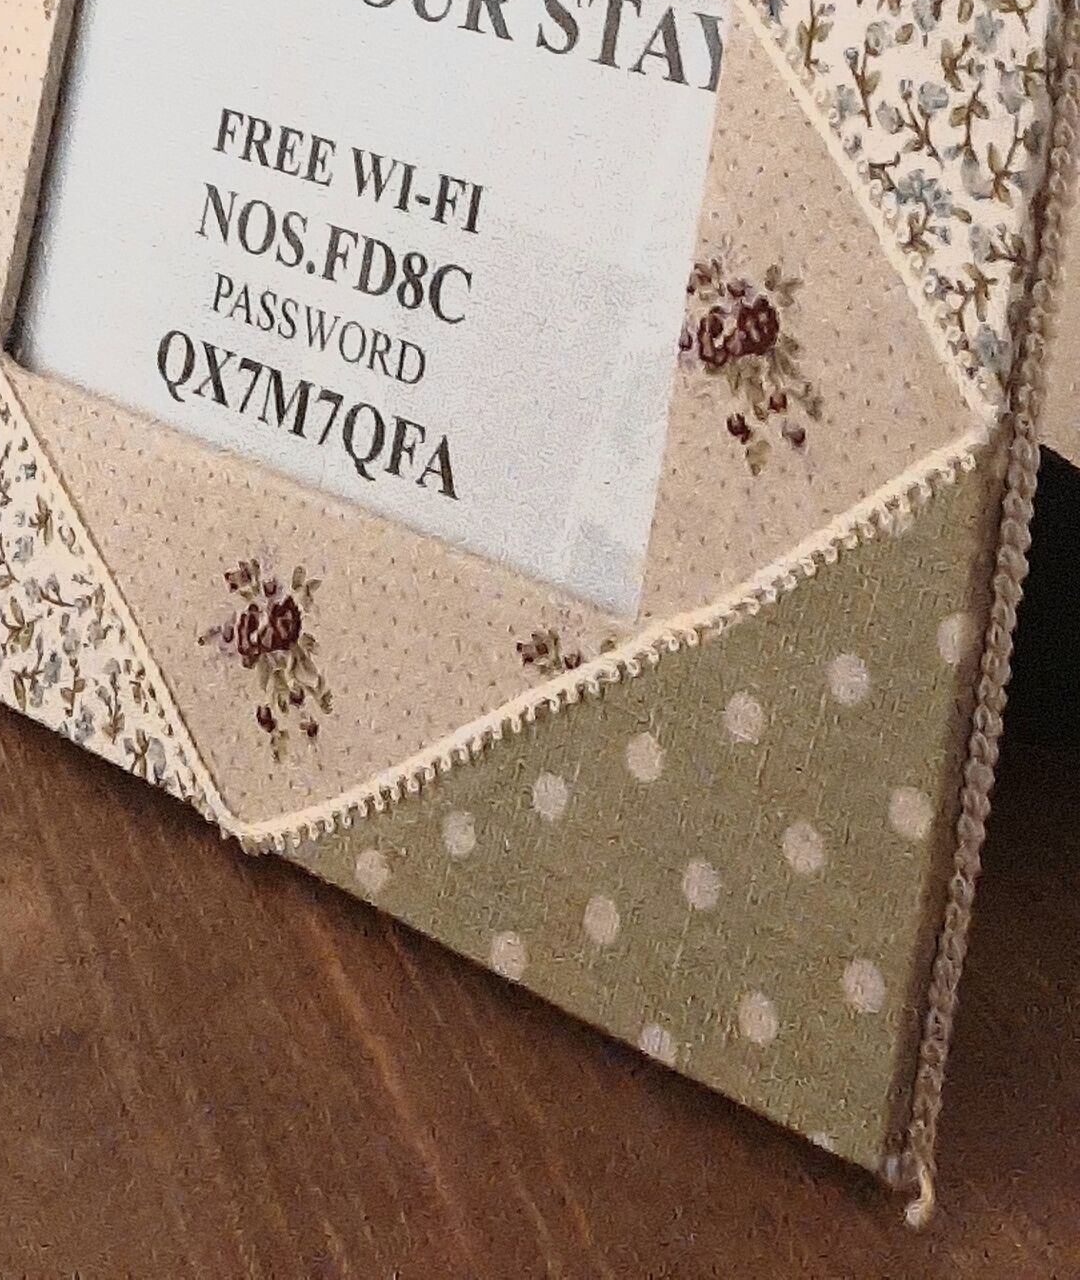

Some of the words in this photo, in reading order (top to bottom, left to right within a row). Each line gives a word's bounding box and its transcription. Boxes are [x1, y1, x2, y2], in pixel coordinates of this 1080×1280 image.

[212, 107, 337, 187] FREE
[351, 146, 486, 234] WI-FI
[195, 182, 473, 325] NOS.FD8C
[211, 272, 427, 385] PASSWORD
[156, 329, 460, 500] QX7M7QFA
